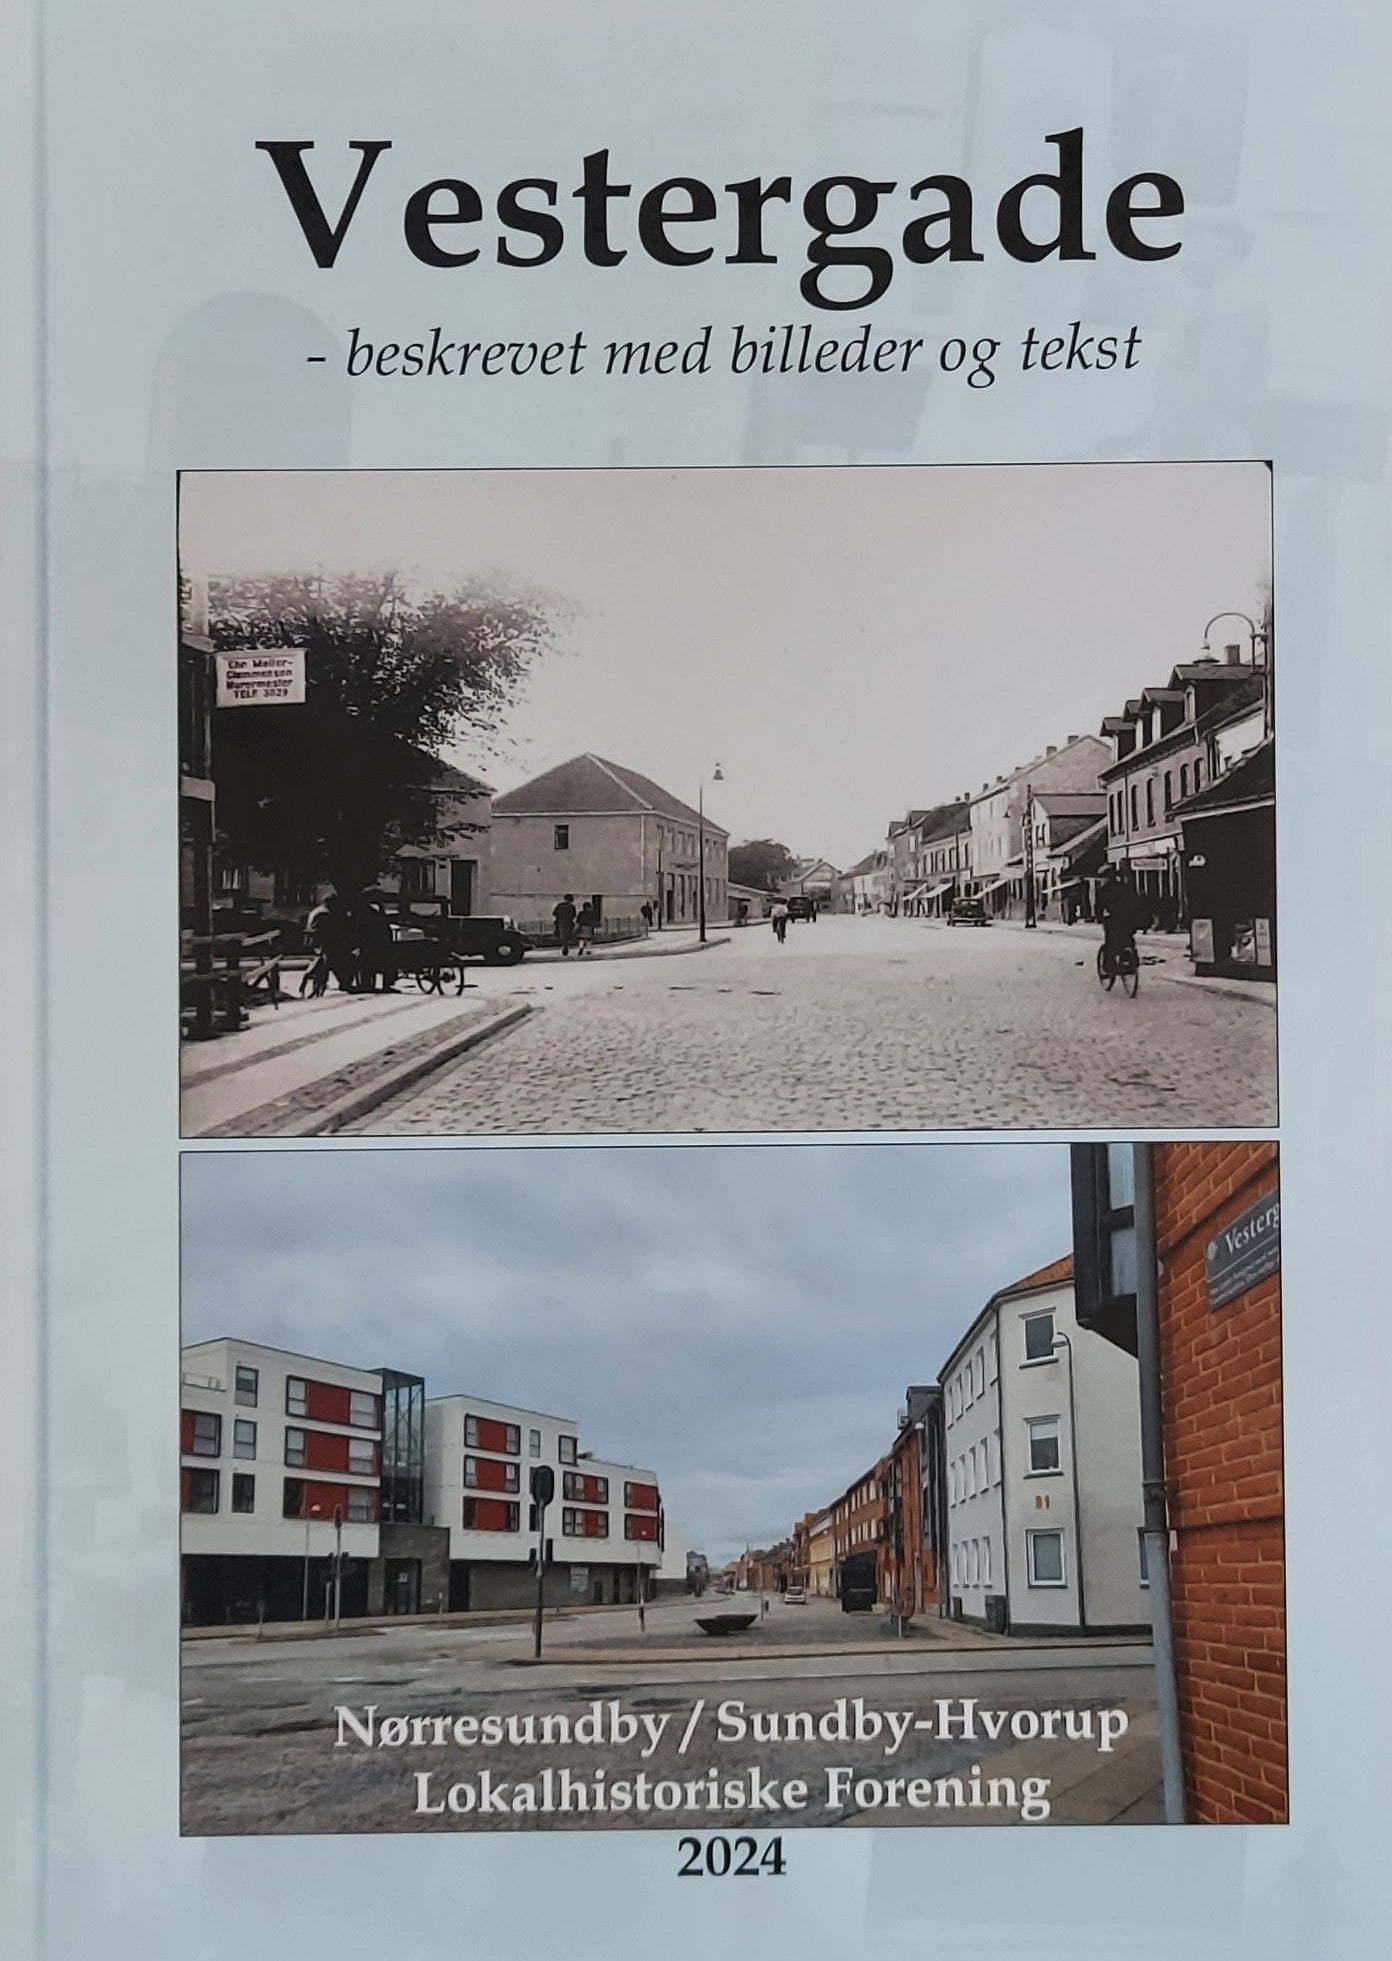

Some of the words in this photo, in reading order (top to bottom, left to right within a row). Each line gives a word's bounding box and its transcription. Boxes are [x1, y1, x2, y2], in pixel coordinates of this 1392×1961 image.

[255, 127, 1185, 311] Vestergade
[347, 327, 588, 377] beskrevet
[605, 325, 713, 375] med
[732, 324, 924, 374] billeder
[940, 339, 1001, 389] og
[1022, 321, 1142, 371] tekst
[335, 1700, 671, 1758] Nørresundby
[717, 1697, 1130, 1756] Sundby-Hvorup
[413, 1767, 808, 1814] Lokalhistoriske
[824, 1764, 1052, 1820] Forening
[677, 1836, 787, 1877] 2024
